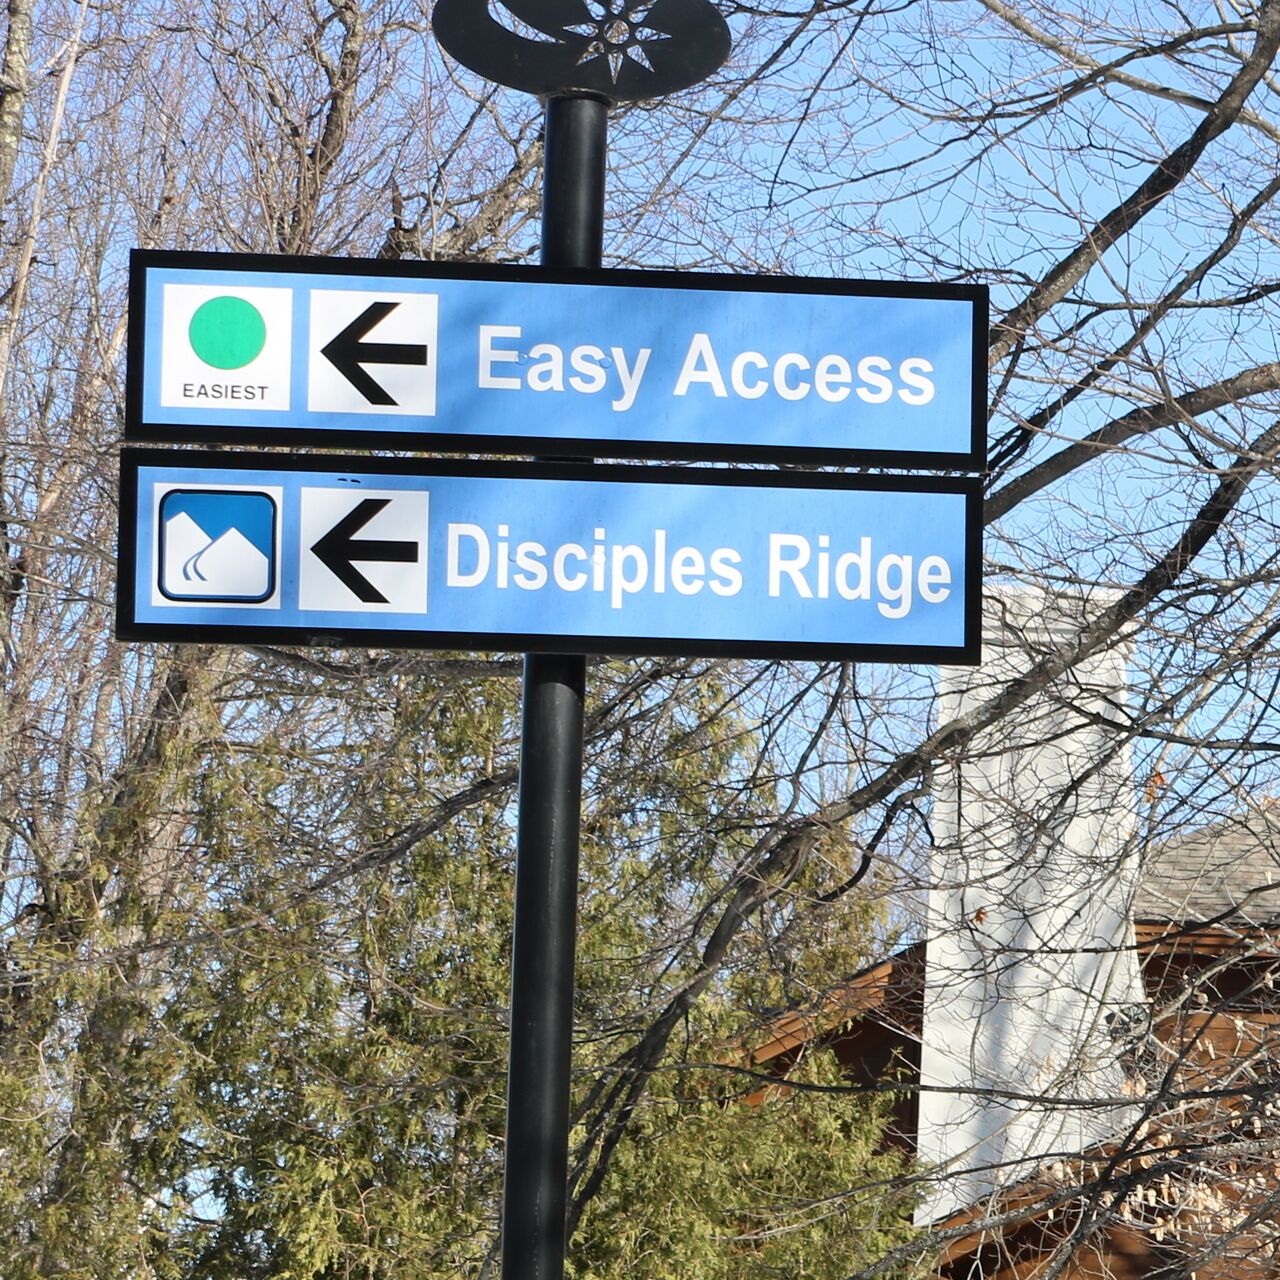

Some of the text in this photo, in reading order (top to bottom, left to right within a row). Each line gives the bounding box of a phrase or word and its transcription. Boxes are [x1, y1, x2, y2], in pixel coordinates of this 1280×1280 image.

[183, 383, 268, 400] EASIEST
[478, 325, 936, 411] Easy Access
[446, 523, 952, 619] Disciples Ridge
